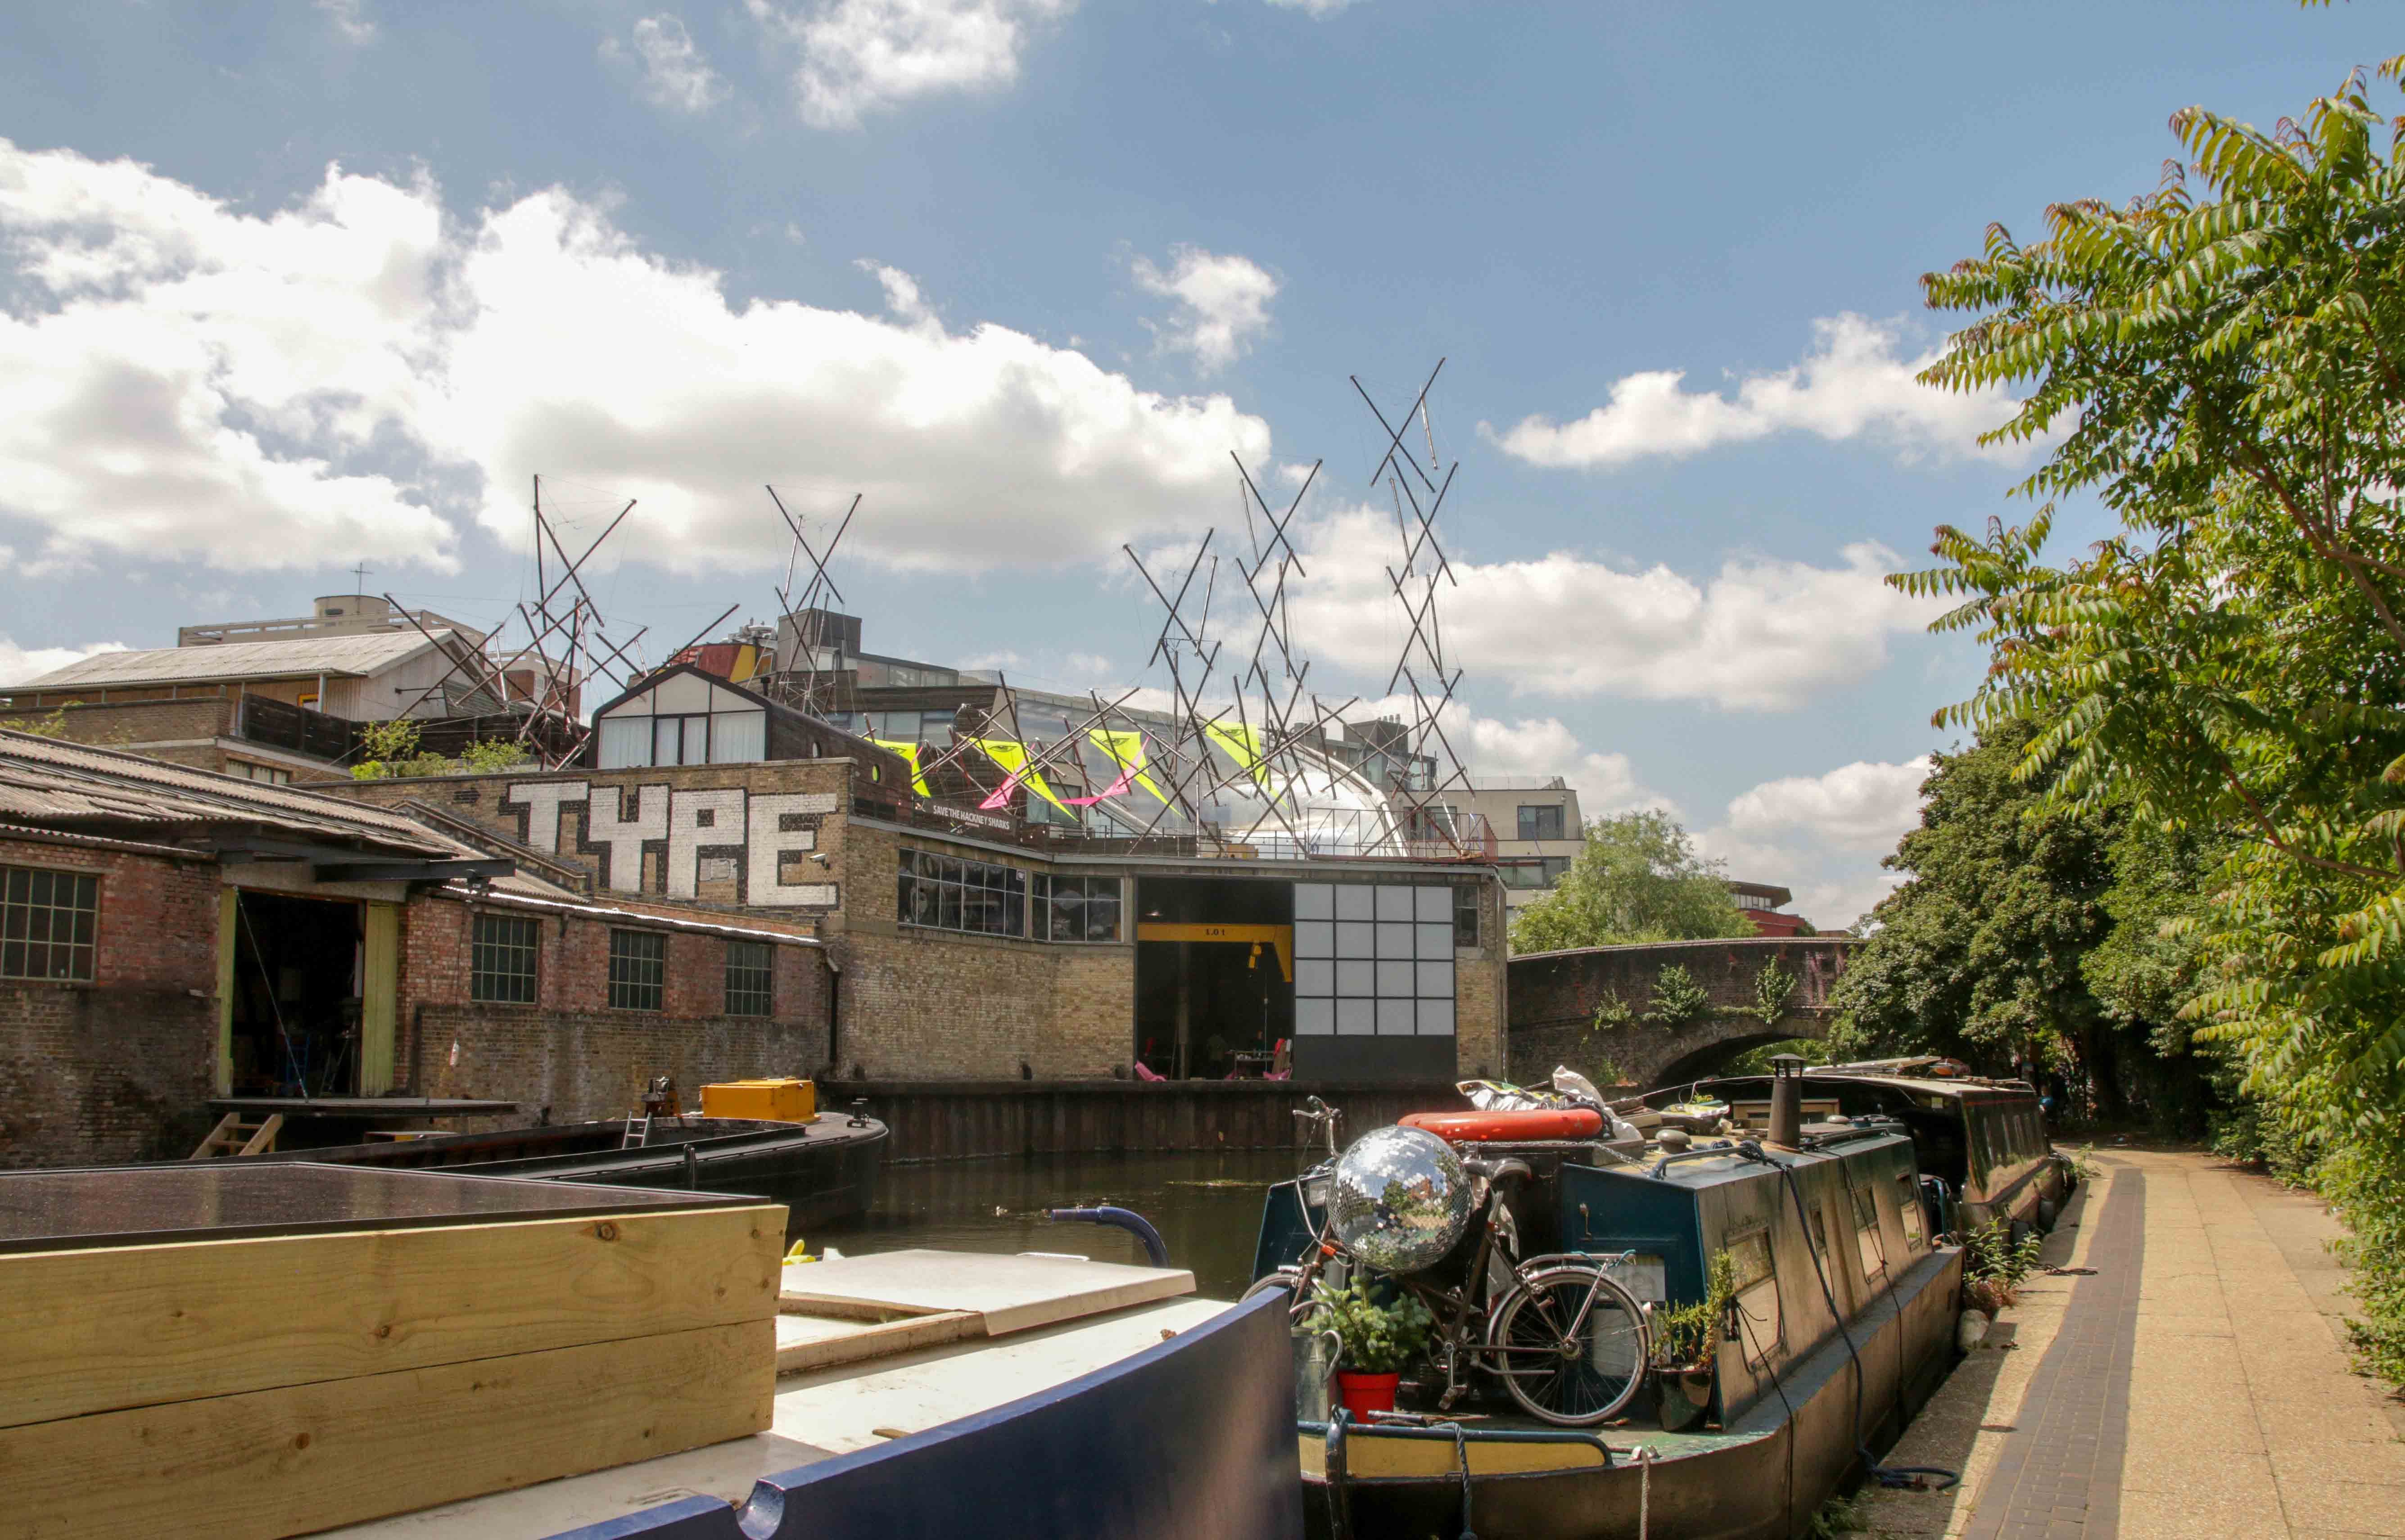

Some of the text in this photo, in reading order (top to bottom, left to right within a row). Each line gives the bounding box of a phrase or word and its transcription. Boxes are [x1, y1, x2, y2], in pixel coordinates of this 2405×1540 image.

[501, 781, 841, 909] TYPE
[933, 805, 949, 817] SAVE
[949, 808, 960, 818] THE
[960, 812, 988, 825] HACKNEY
[988, 817, 1010, 830] SHARKS
